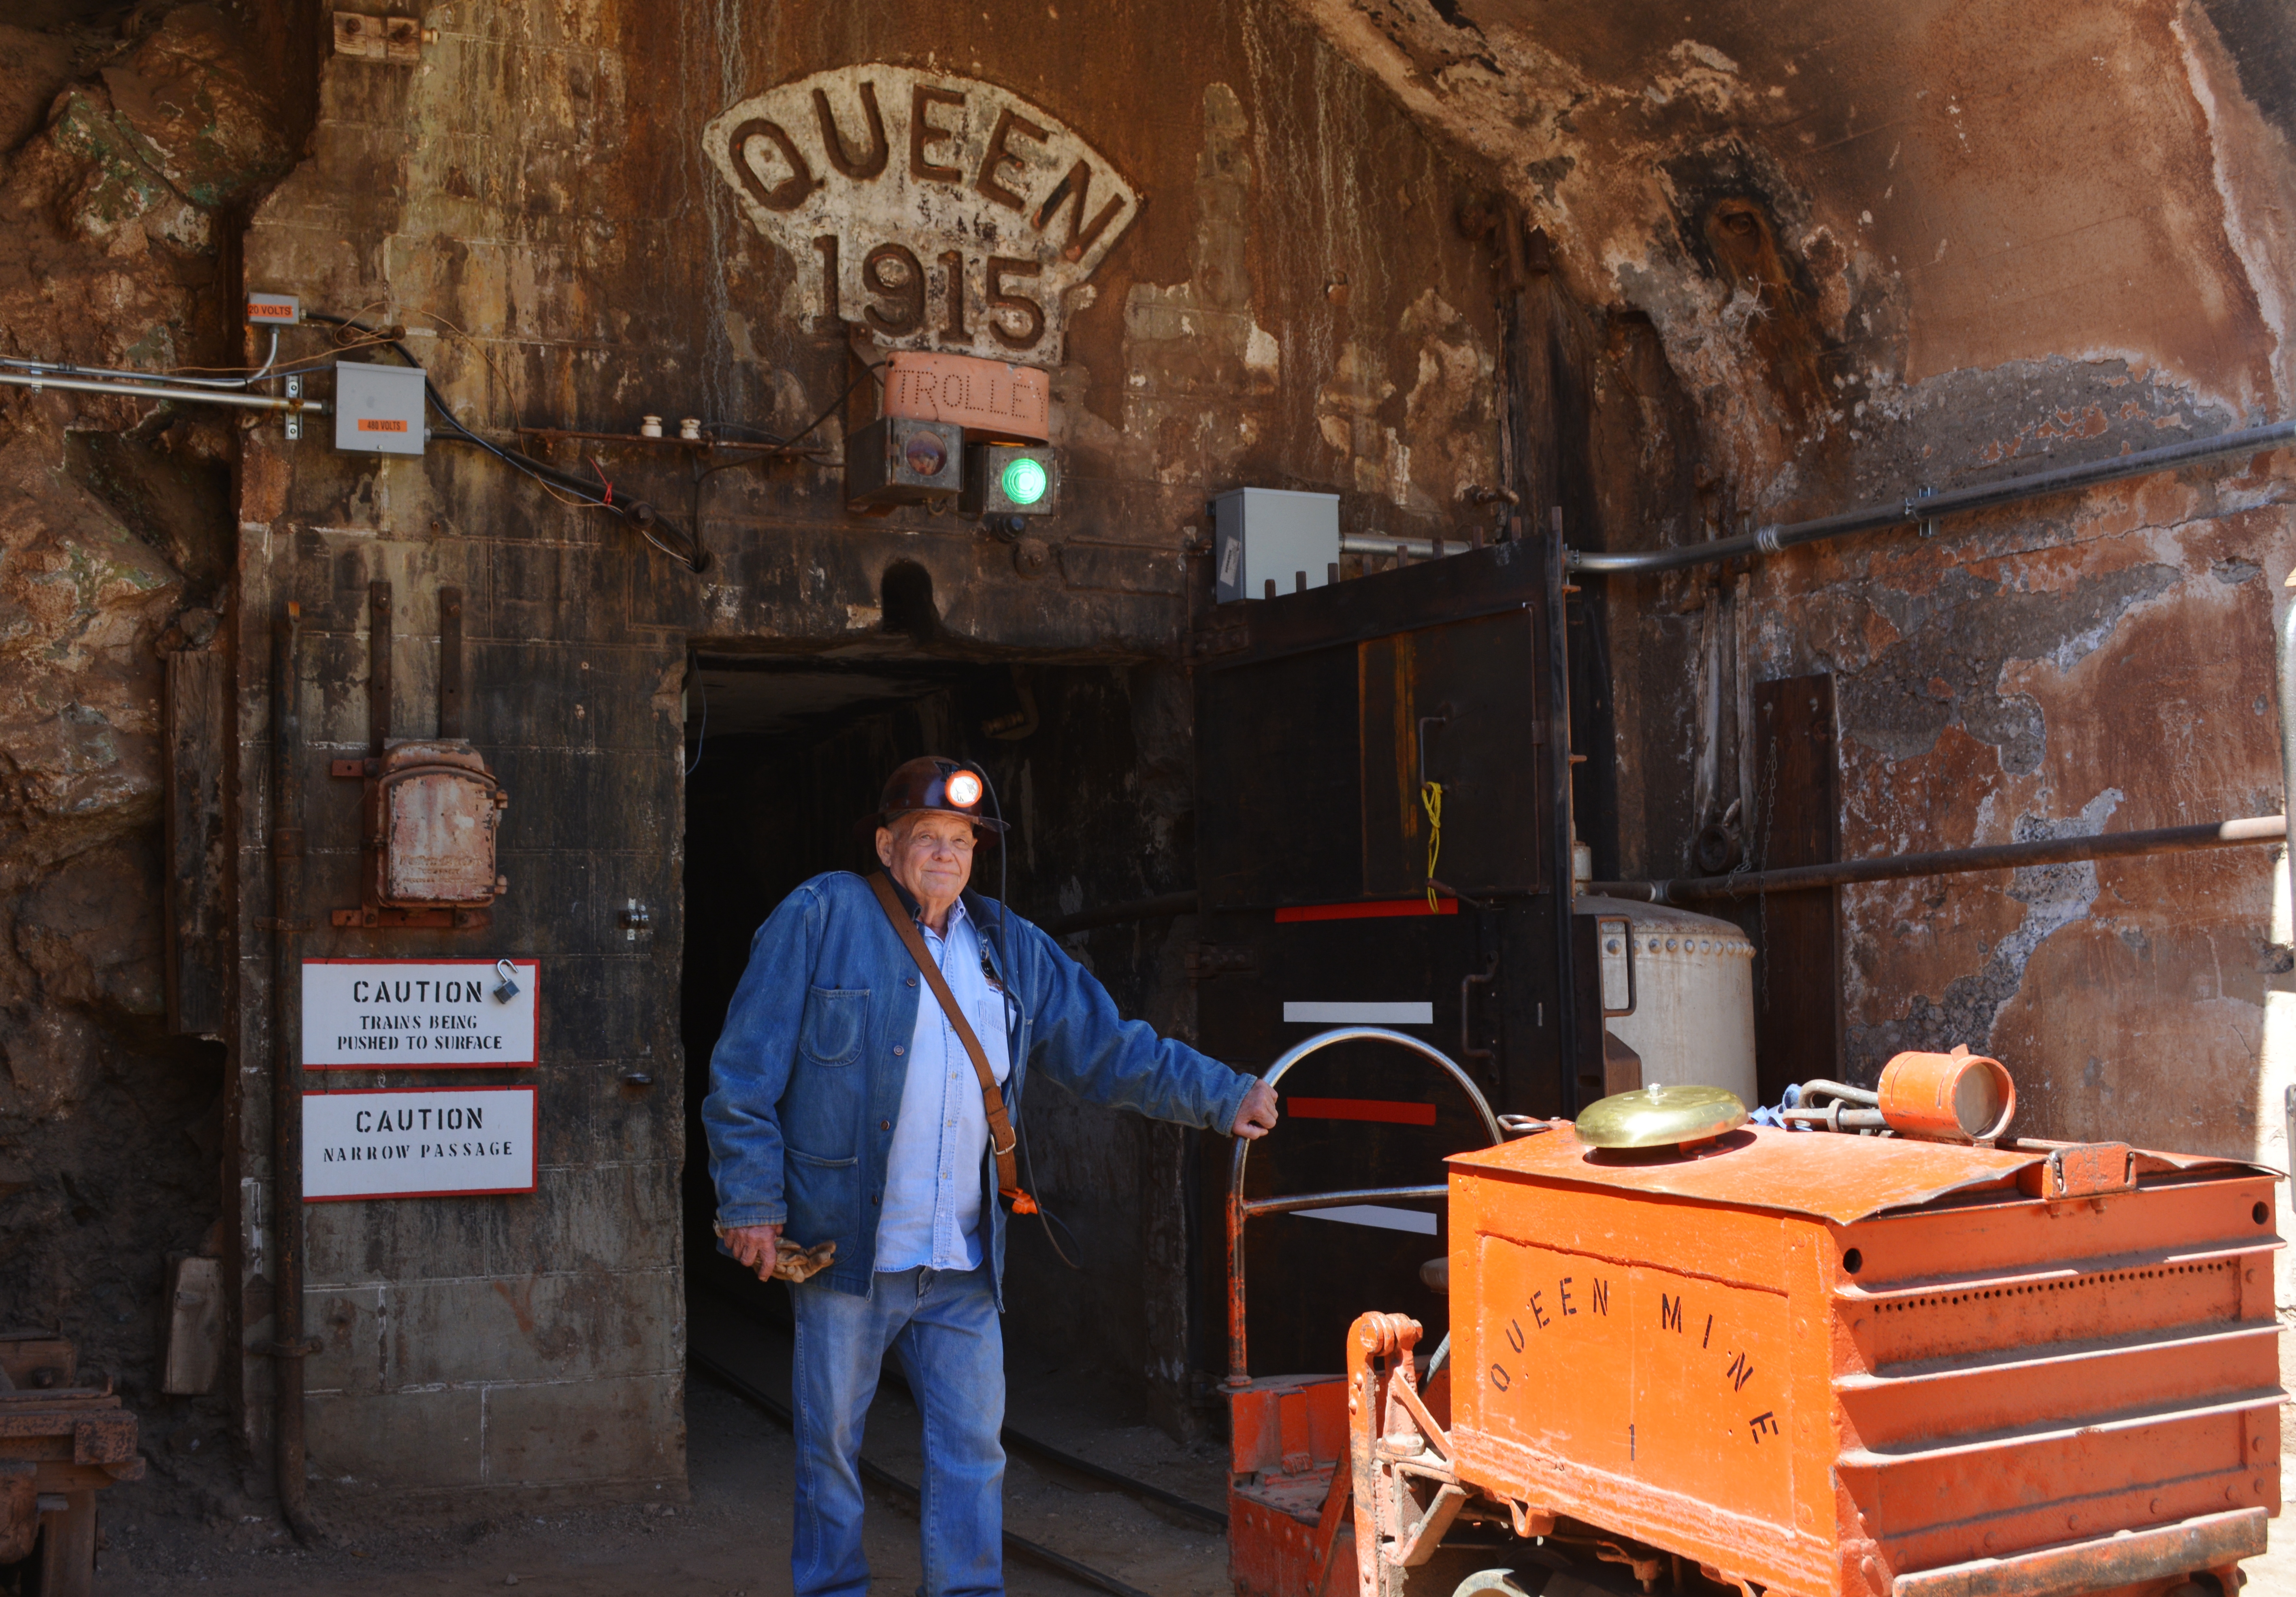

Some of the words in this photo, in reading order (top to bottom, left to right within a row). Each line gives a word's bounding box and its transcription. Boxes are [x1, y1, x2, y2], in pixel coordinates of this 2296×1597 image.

[729, 80, 1127, 263] QUEEN
[812, 234, 1045, 350] 1915
[261, 306, 291, 315] VOLTS
[367, 421, 379, 430] 480
[380, 421, 400, 430] VOLTS
[354, 981, 482, 1003] CAUTION
[360, 1016, 421, 1030] TRAINS
[429, 1016, 477, 1029] BEING
[338, 1036, 398, 1050] PUSHED
[406, 1036, 428, 1050] TO
[434, 1036, 502, 1050] SURFACE
[356, 1107, 483, 1133] CAUTION
[324, 1145, 410, 1162] NARROW
[421, 1141, 512, 1158] PASSAGE
[1490, 1277, 1608, 1392] QUEEN
[1662, 1293, 1779, 1444] MINE
[1628, 1423, 1635, 1461] 1
